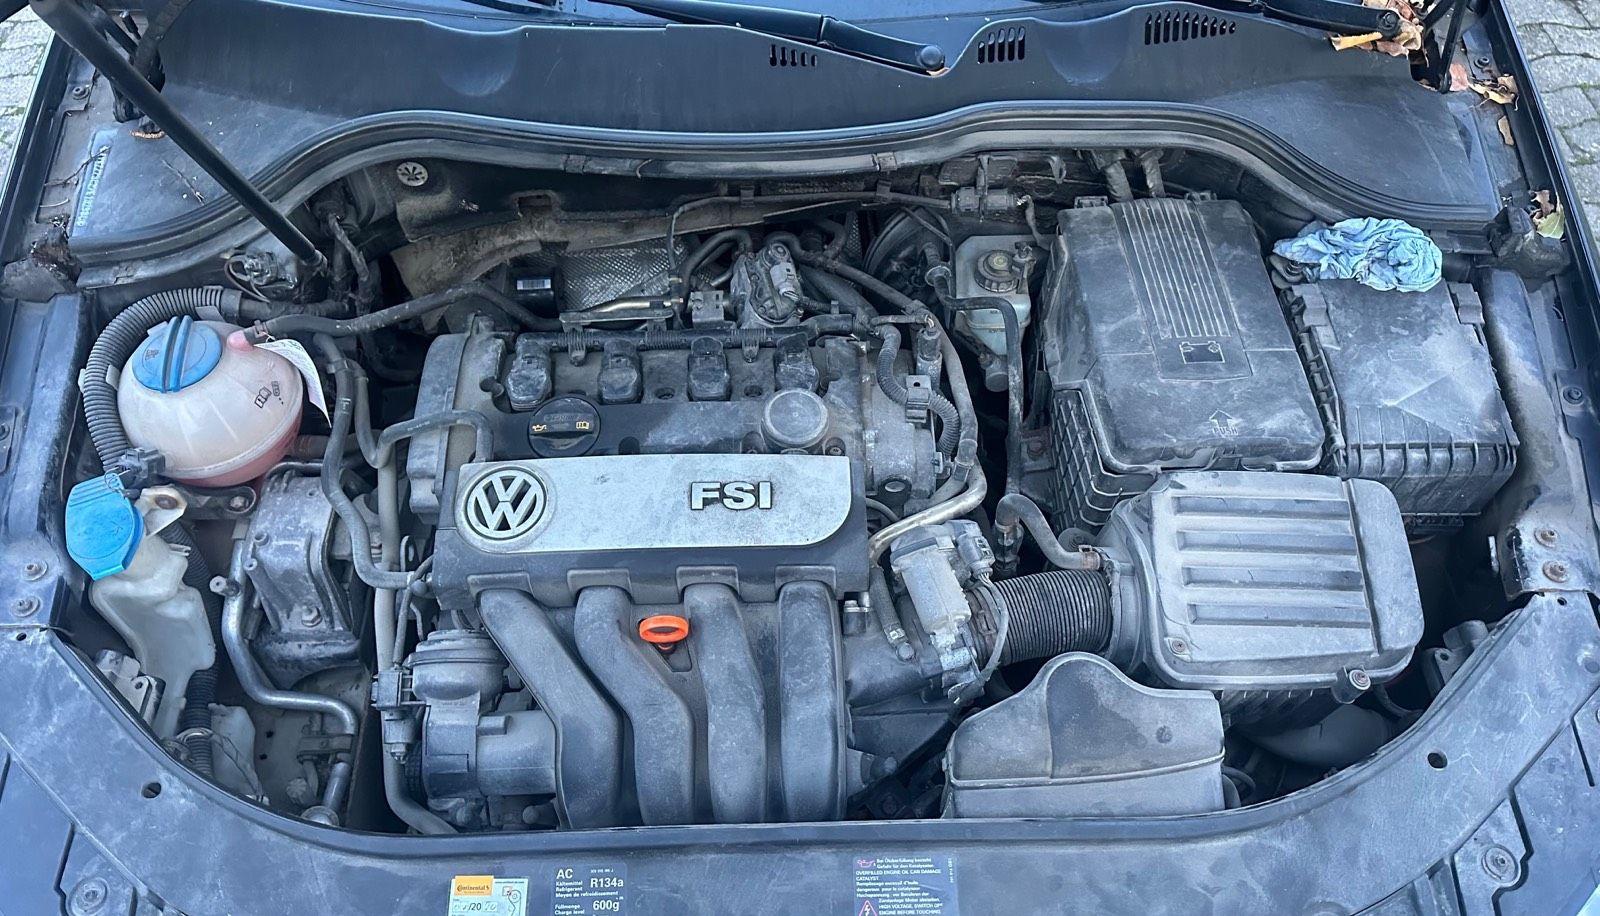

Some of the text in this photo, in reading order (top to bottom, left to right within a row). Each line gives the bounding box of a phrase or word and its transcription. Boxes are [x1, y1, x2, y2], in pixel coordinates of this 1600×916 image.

[1212, 426, 1239, 436] PUSH
[690, 481, 773, 511] FSI
[556, 869, 573, 879] AC
[590, 877, 624, 888] R134a
[592, 900, 620, 912] 600g
